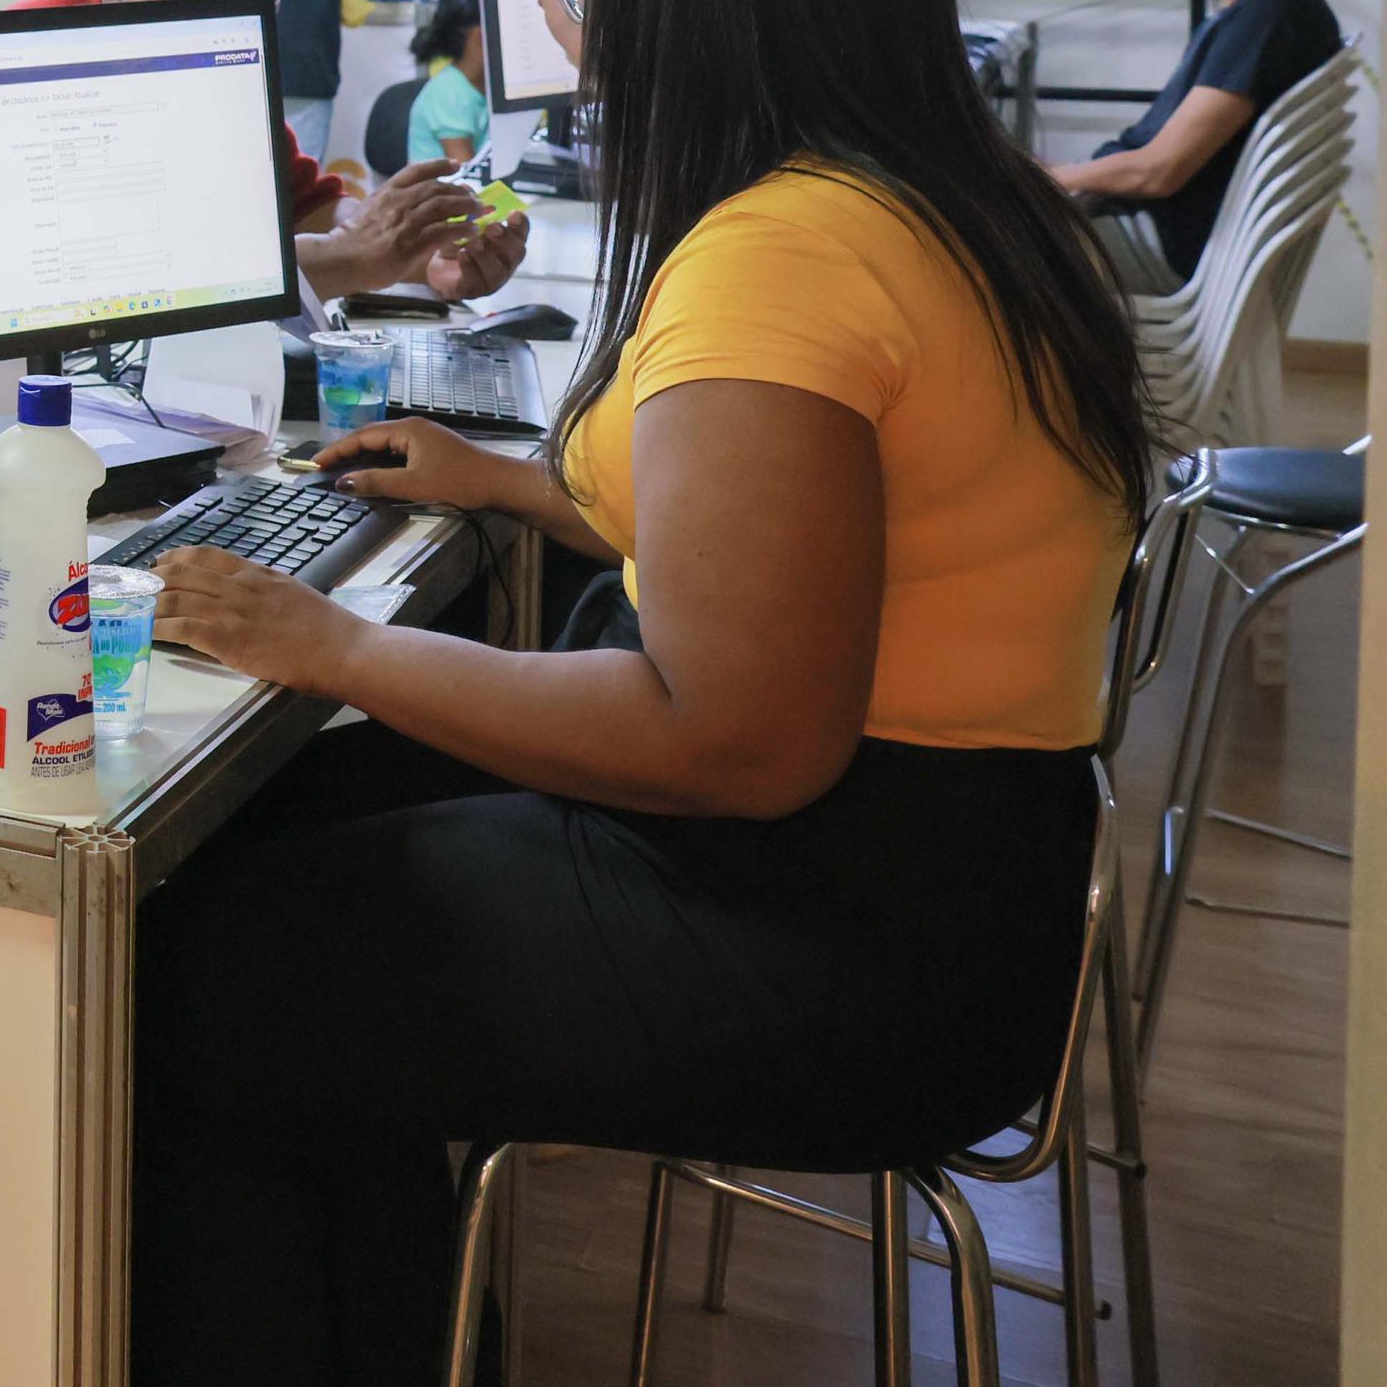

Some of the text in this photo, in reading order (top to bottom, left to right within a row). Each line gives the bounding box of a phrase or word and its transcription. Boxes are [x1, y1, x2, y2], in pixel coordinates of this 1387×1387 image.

[103, 702, 115, 712] 200
[35, 735, 92, 755] Tradicional
[31, 765, 51, 778] ANTES
[52, 766, 60, 777] DE
